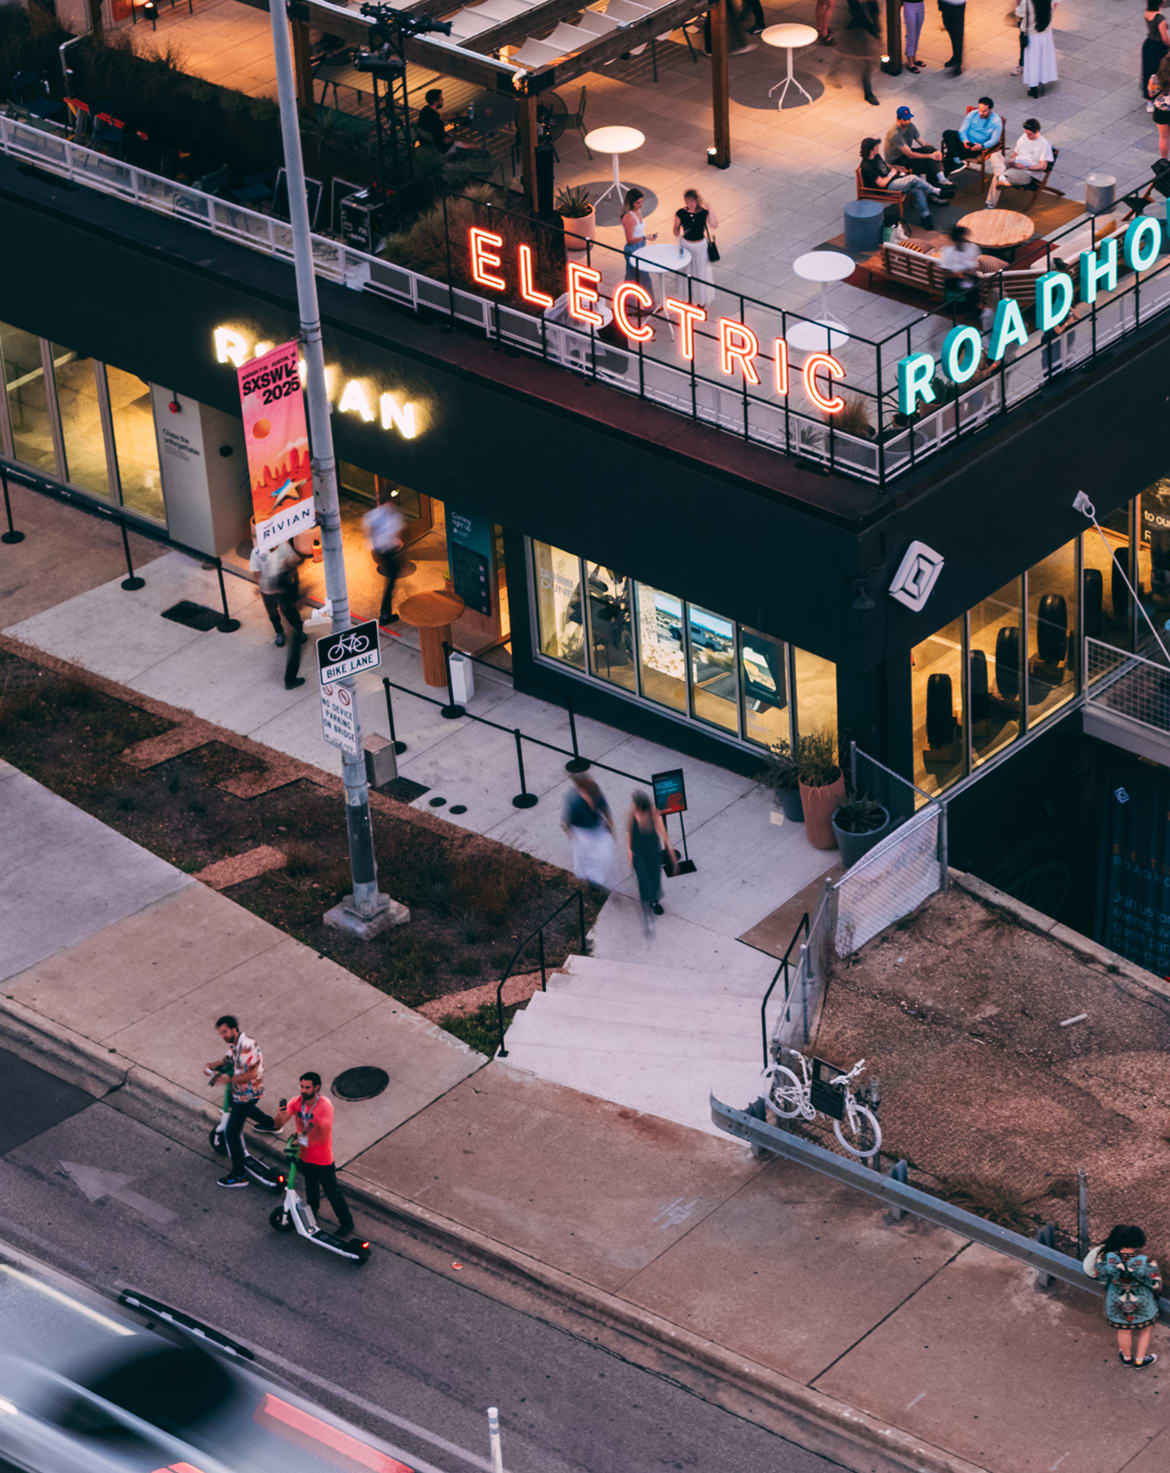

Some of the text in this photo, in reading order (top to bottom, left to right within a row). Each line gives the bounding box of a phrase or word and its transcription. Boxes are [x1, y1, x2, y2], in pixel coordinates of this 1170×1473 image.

[470, 226, 846, 414] ELECTRIC
[262, 376, 300, 405] 2025
[263, 508, 310, 540] RIVIAN
[1144, 509, 1155, 522] to
[326, 654, 374, 679] BIKE LANE
[1112, 891, 1137, 910] Jin
